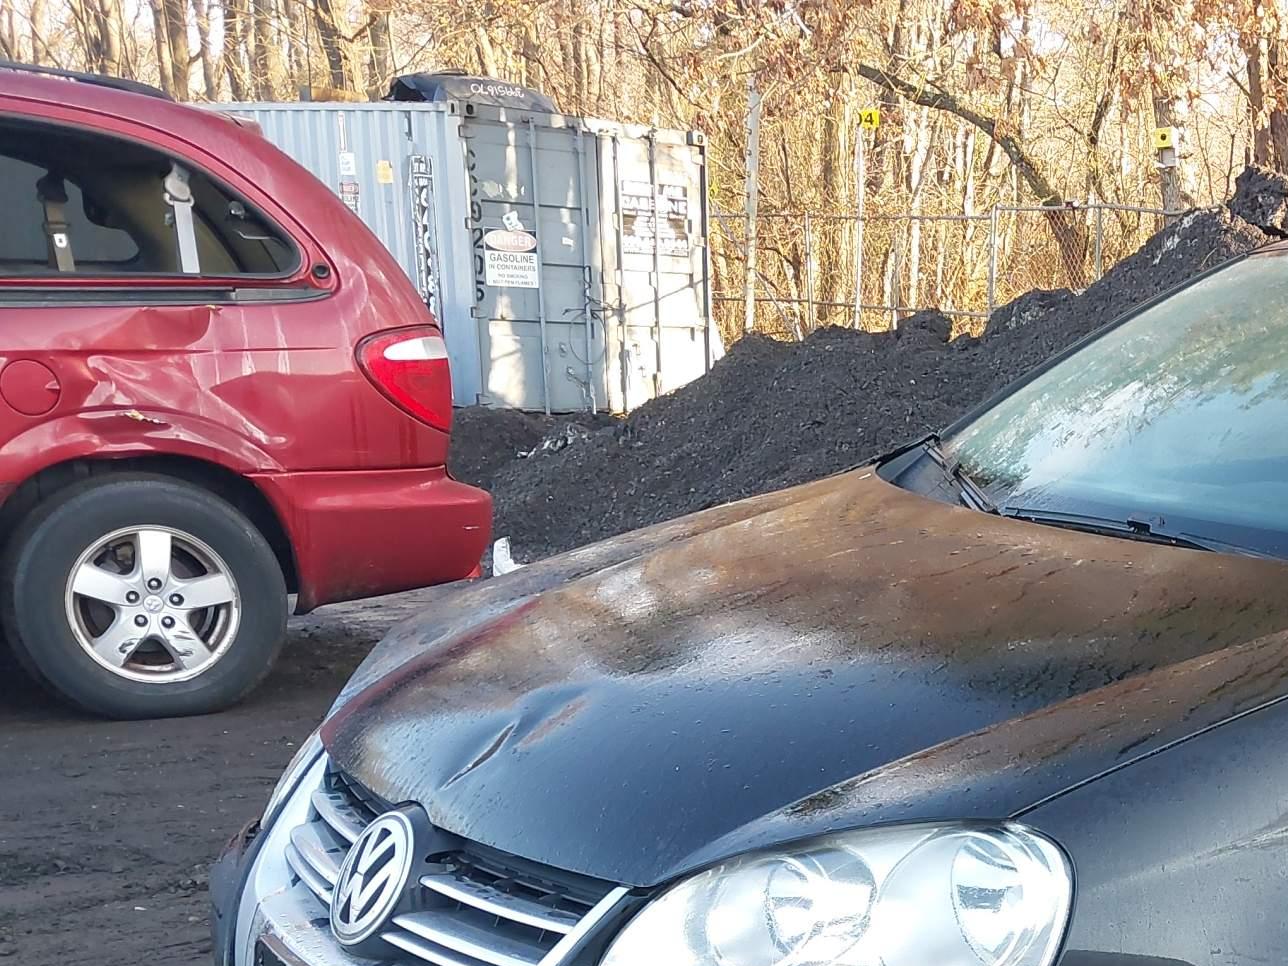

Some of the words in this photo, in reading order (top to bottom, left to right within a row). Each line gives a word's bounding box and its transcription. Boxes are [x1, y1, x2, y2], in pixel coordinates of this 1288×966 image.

[487, 233, 532, 248] DANGER
[489, 252, 535, 264] GASOLINE
[496, 264, 537, 272] CONTAINERS
